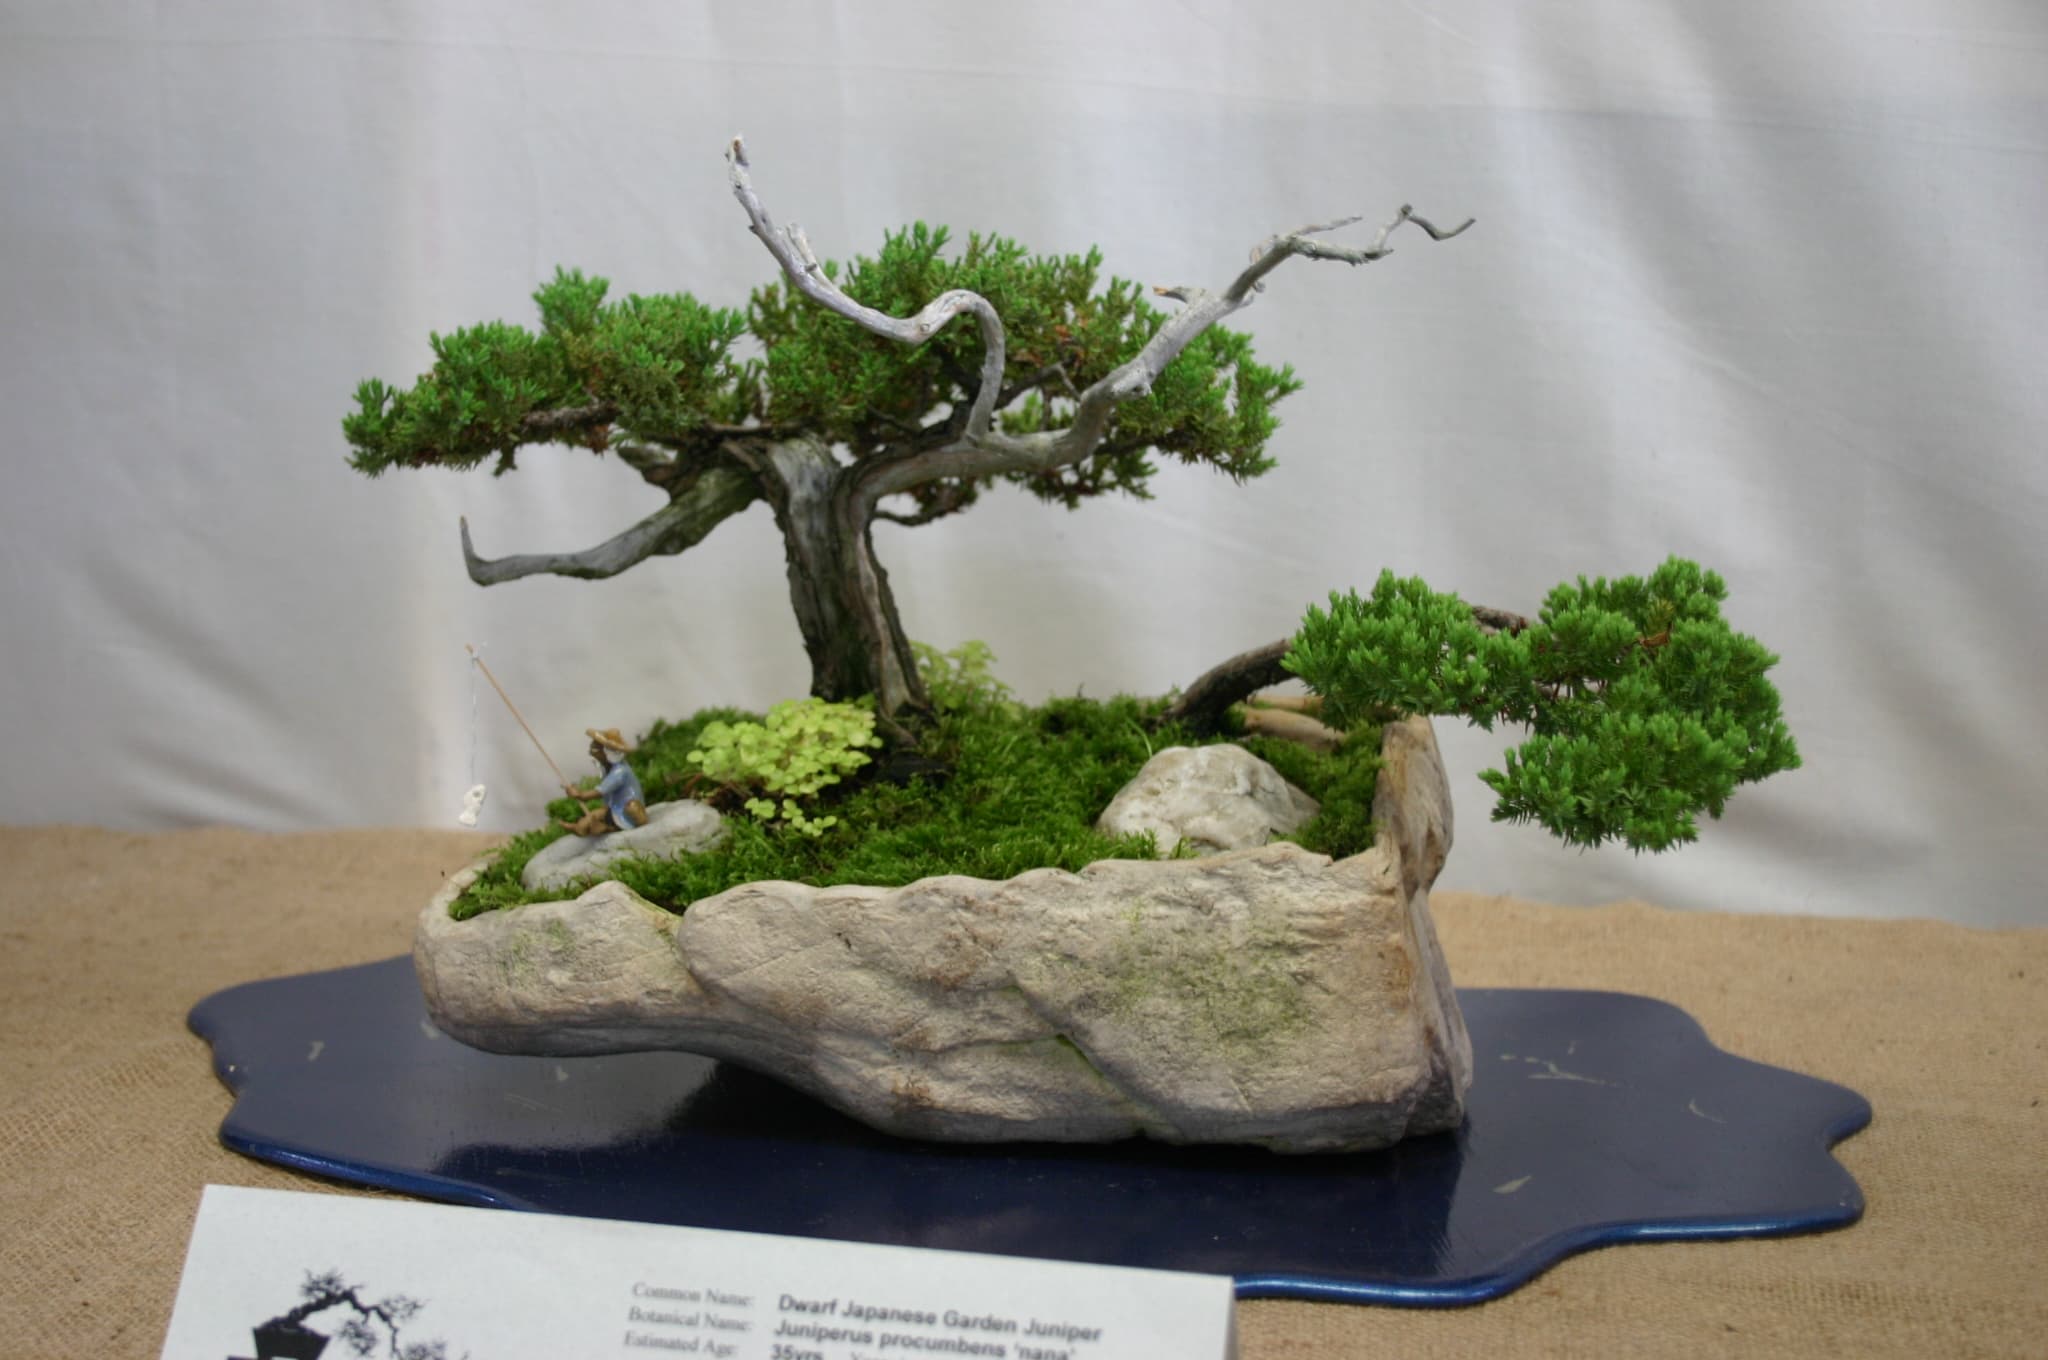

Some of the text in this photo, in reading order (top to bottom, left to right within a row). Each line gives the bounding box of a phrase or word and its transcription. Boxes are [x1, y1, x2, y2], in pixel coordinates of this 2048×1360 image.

[628, 1305, 701, 1327] Botanical
[774, 1319, 873, 1343] Juniperus
[879, 1330, 1006, 1358] procumbens
[632, 1281, 701, 1302] Common
[778, 1294, 837, 1315] Dwarf
[842, 1300, 937, 1324] Japanese
[943, 1310, 1018, 1332] Garden
[1024, 1318, 1103, 1342] Juniper
[624, 1330, 699, 1352] Estimated
